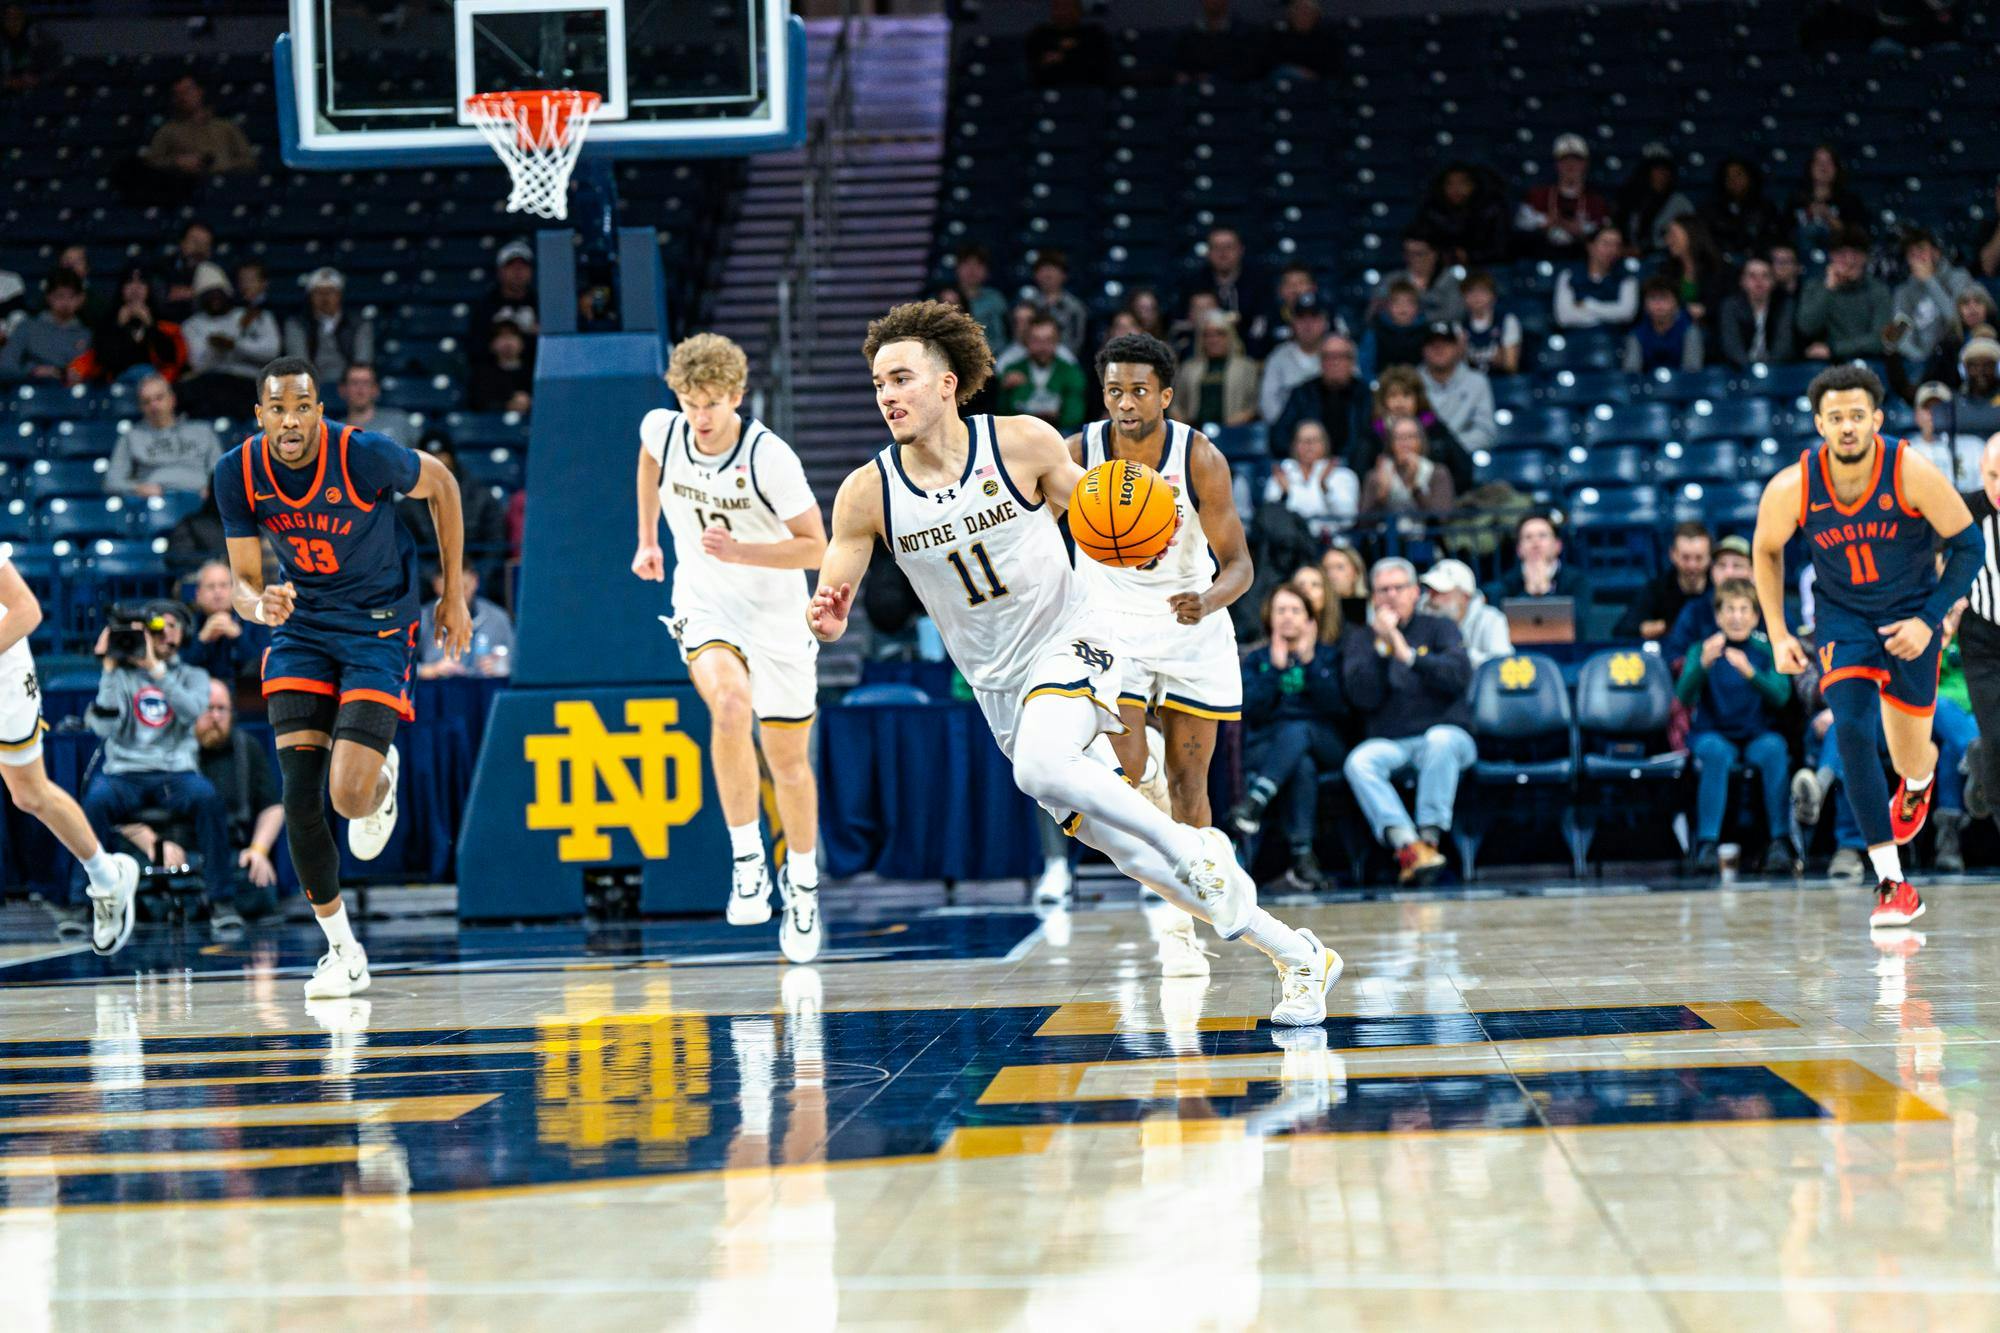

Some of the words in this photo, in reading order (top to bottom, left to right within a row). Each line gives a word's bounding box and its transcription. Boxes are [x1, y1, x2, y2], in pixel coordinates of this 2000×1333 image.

[673, 482, 709, 505] NOTRE
[713, 497, 751, 510] DAME
[265, 512, 353, 536] VIRGINIA
[898, 523, 956, 553] NOTRE
[963, 500, 1018, 535] DAME
[1814, 521, 1898, 550] VIRGINIA
[287, 536, 340, 574] 33
[947, 540, 1009, 607] 11
[1845, 542, 1879, 585] 11
[524, 698, 702, 862] ND
